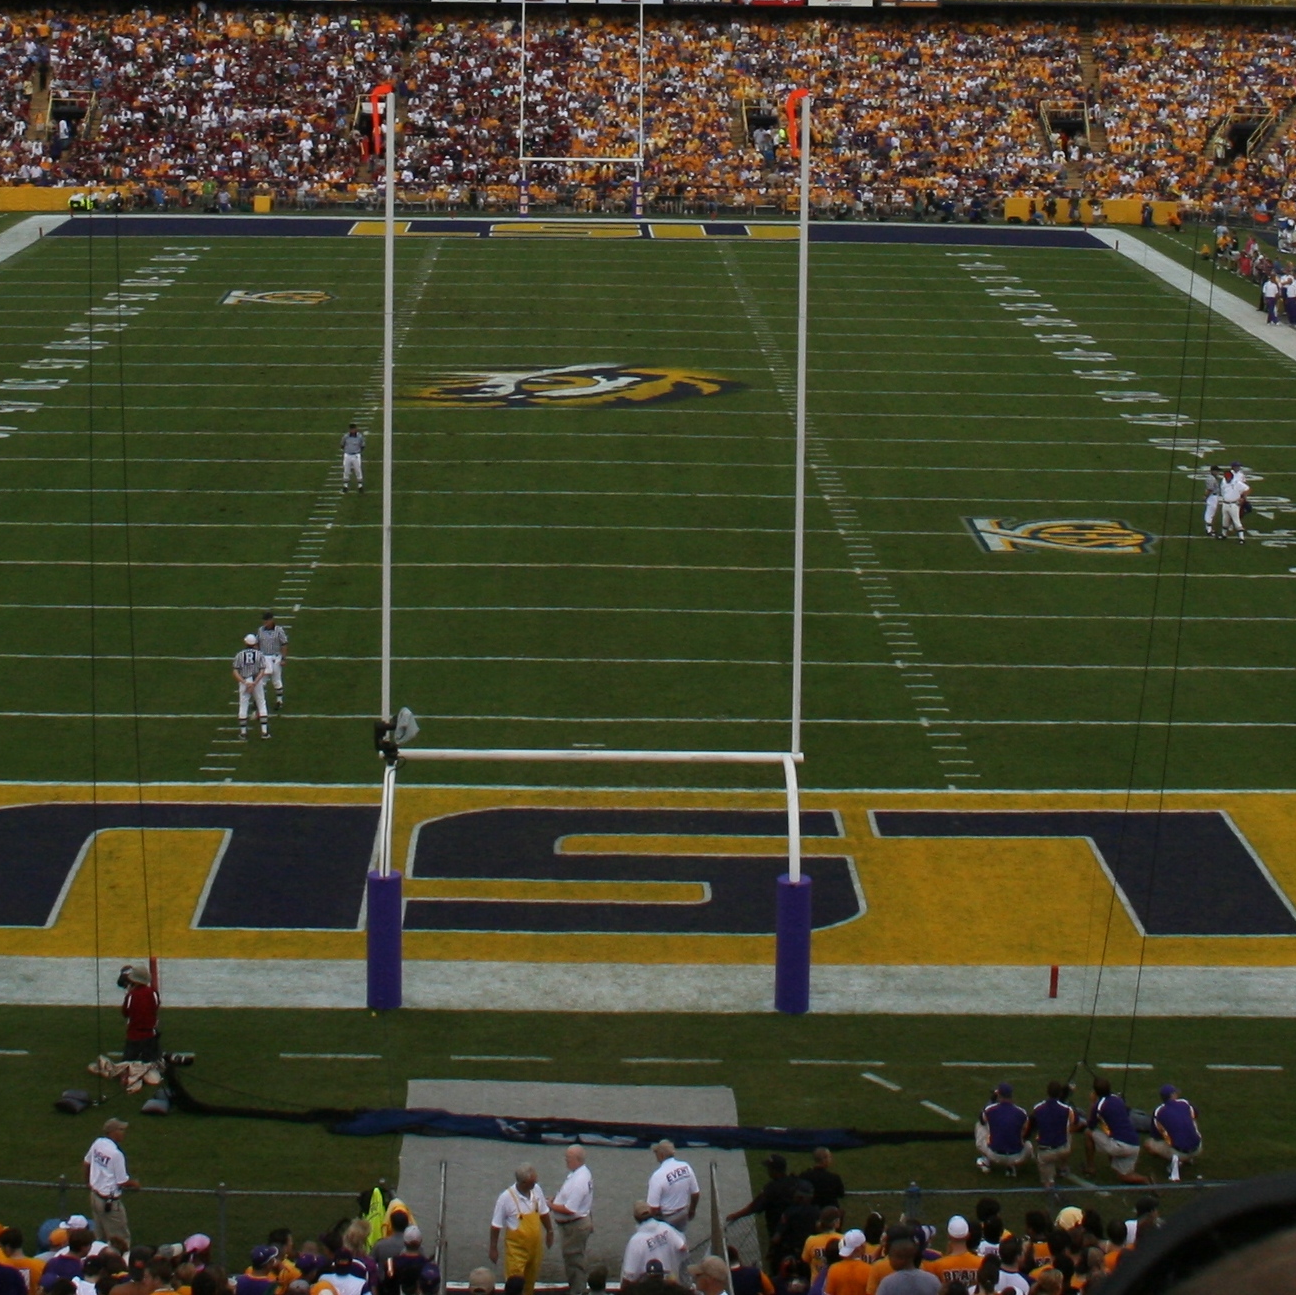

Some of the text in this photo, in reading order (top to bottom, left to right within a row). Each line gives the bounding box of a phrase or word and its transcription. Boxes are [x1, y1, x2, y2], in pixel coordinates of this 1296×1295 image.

[348, 221, 802, 239] LSU
[245, 653, 254, 664] R
[666, 1165, 690, 1183] EVENT
